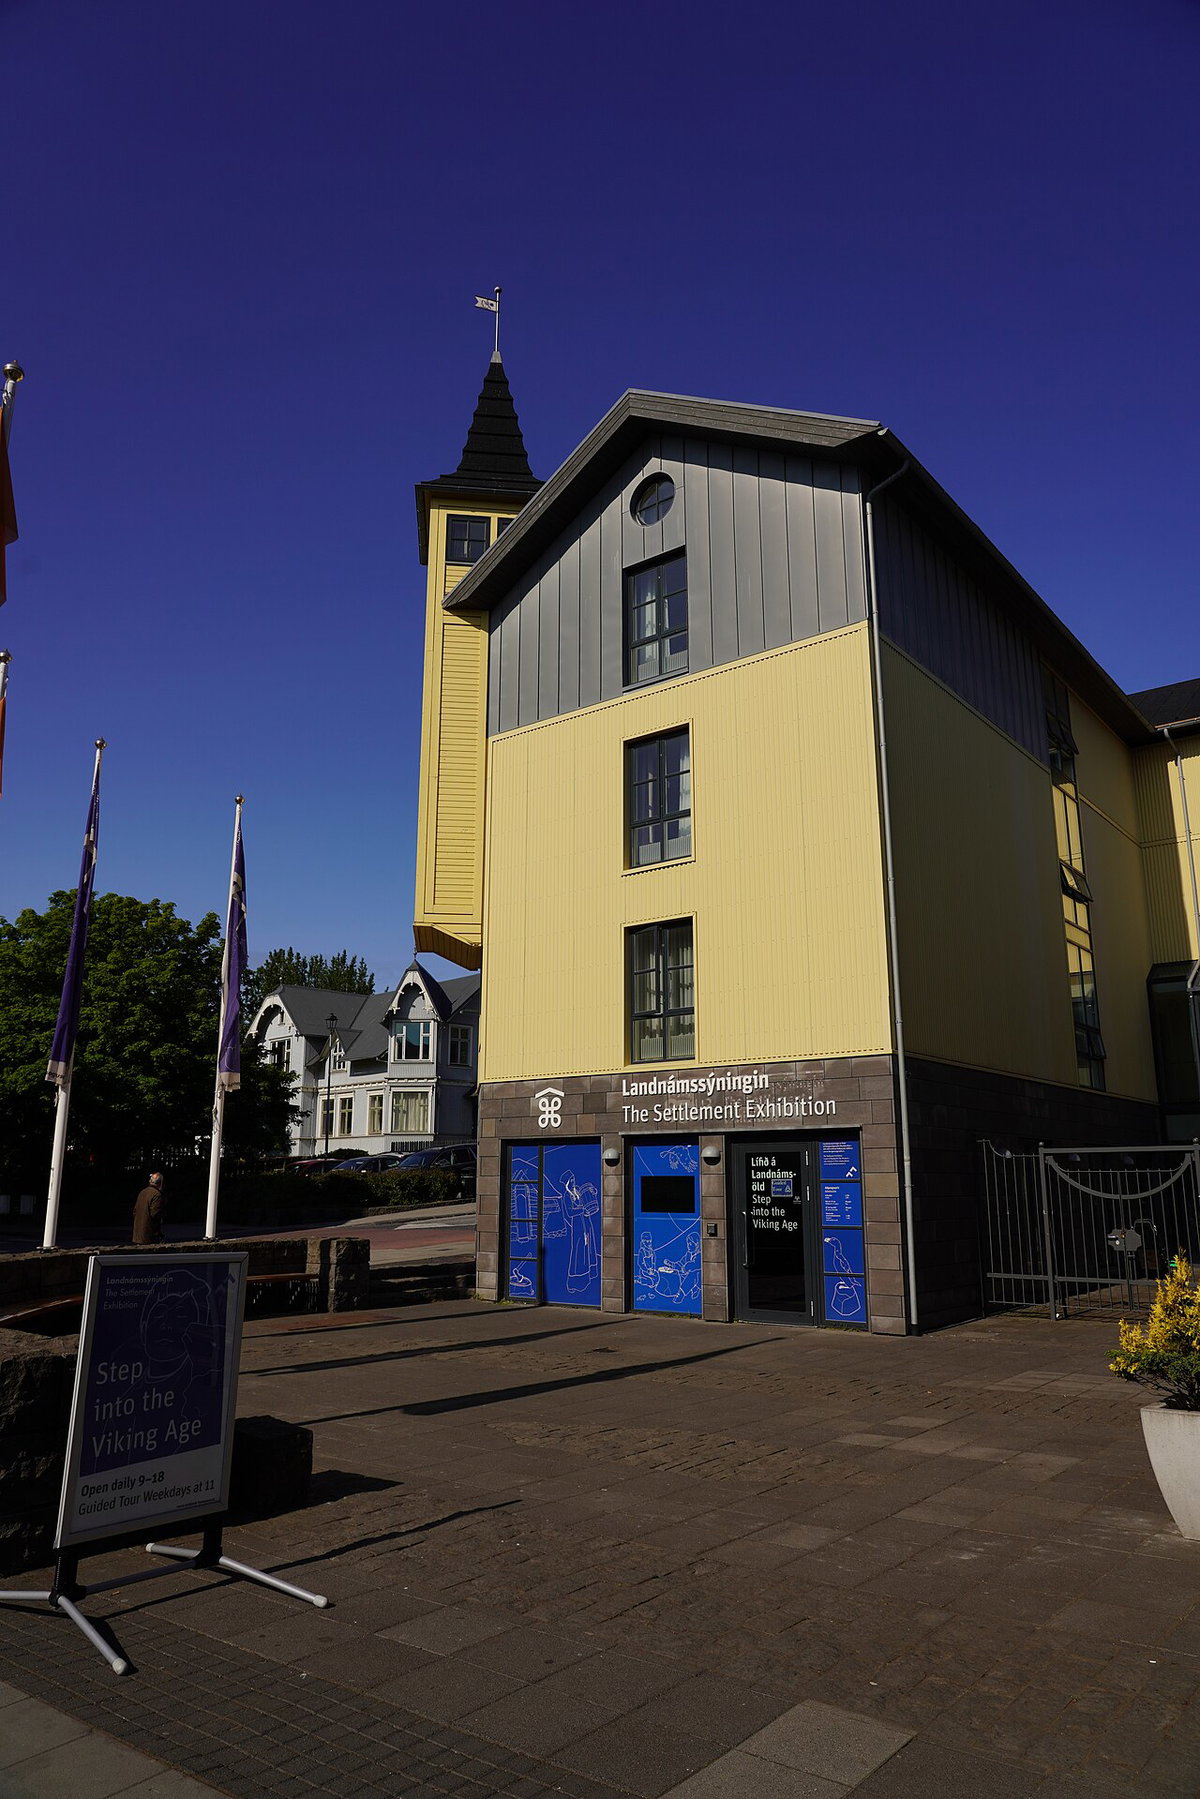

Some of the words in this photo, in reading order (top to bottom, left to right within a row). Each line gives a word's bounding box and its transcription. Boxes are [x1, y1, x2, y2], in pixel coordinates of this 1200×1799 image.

[623, 1070, 769, 1096] Landnámssýningin
[623, 1105, 649, 1123] The
[653, 1101, 741, 1121] Settlement
[746, 1096, 836, 1118] Exhibition
[751, 1157, 769, 1166] Lífið
[771, 1157, 776, 1166] á
[751, 1168, 796, 1179] Landnáms-
[752, 1182, 765, 1191] öld
[752, 1194, 771, 1206] Step
[753, 1206, 769, 1216] into
[772, 1206, 785, 1216] the
[753, 1219, 779, 1231] Viking
[782, 1220, 798, 1231] Age
[105, 1289, 117, 1297] The
[104, 1301, 138, 1310] Exhibition
[96, 1361, 143, 1384] Step
[94, 1396, 135, 1421] into
[143, 1388, 175, 1410] the
[92, 1430, 158, 1457] Viking
[165, 1418, 201, 1443] Age
[81, 1484, 108, 1497] Open
[112, 1476, 136, 1490] daily
[79, 1498, 115, 1515] Guided
[120, 1495, 140, 1507] Tour
[144, 1485, 191, 1502] Weekdays
[193, 1483, 202, 1492] at
[205, 1480, 215, 1490] 11
